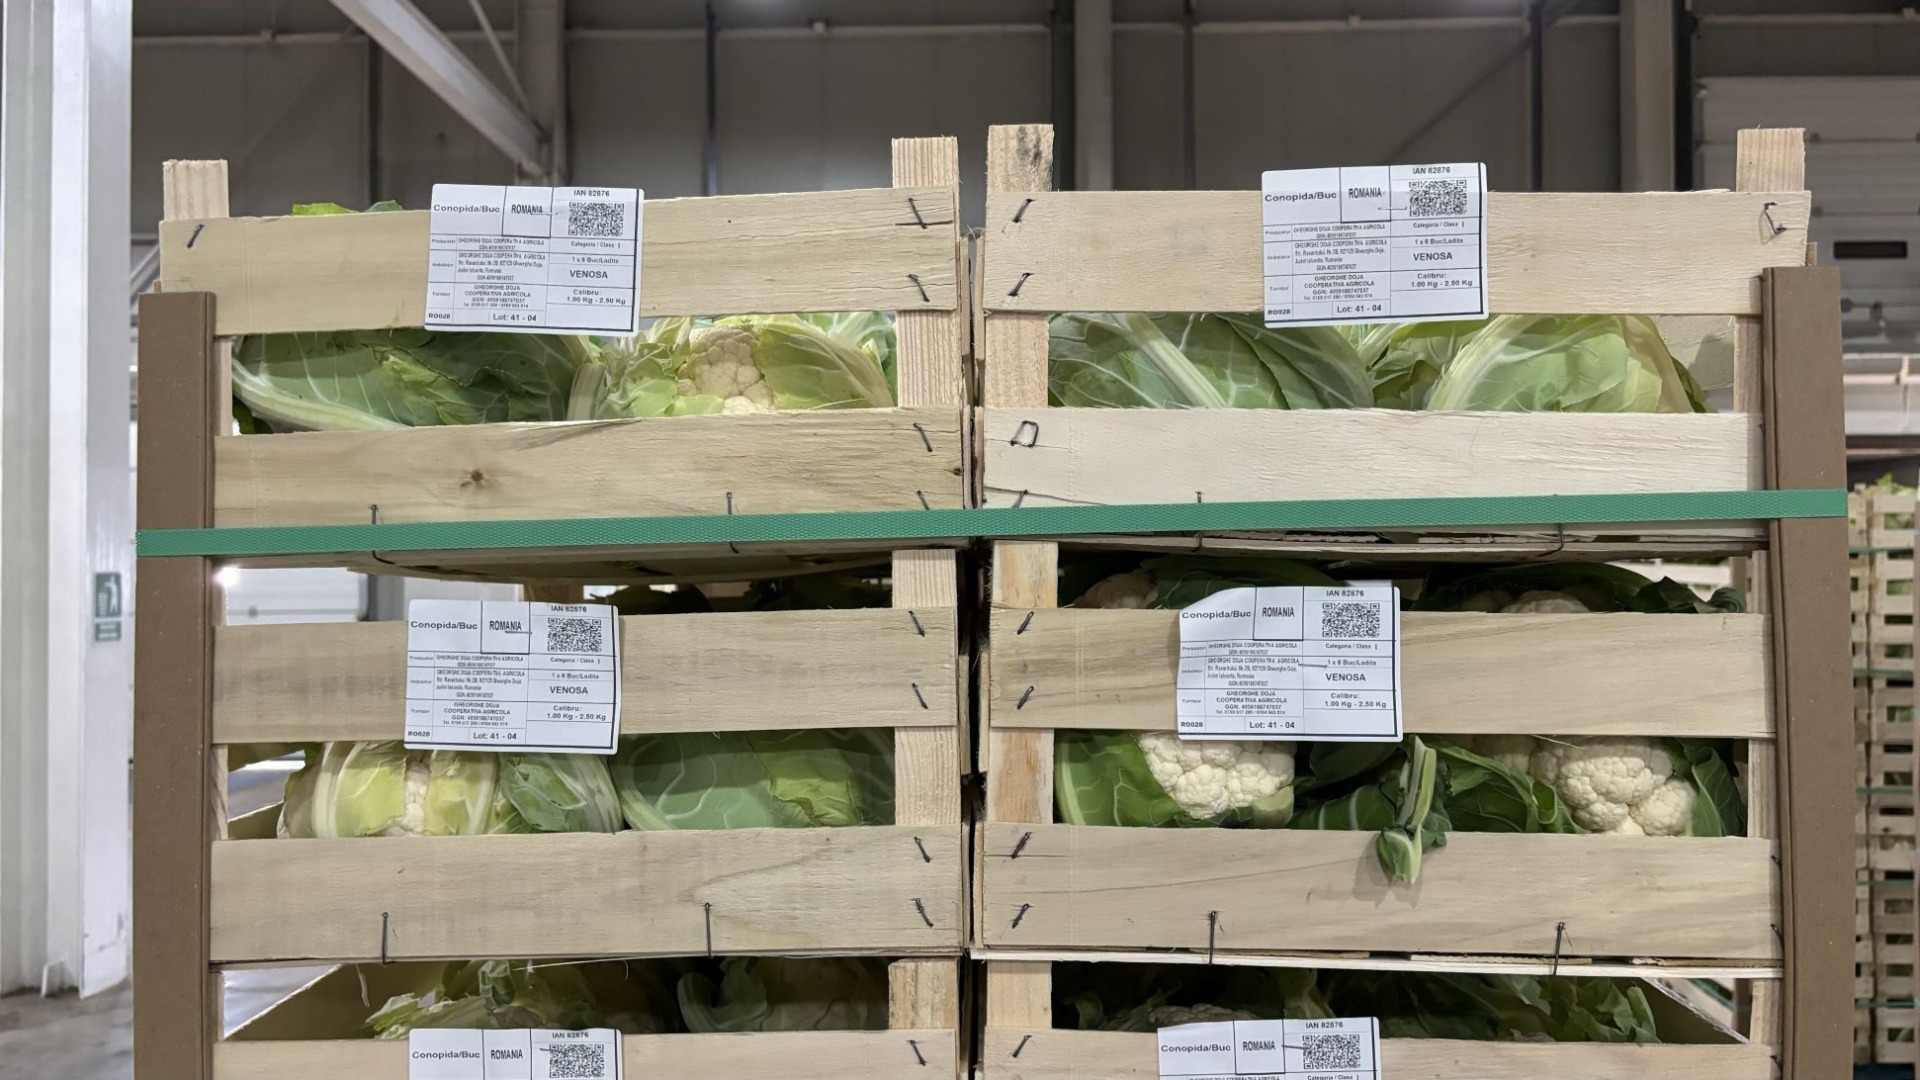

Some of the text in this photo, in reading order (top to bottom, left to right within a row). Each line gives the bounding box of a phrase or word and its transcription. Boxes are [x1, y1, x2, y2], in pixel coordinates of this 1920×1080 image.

[1265, 192, 1337, 202] Conopida/Buc
[1348, 188, 1382, 199] ROMANIA
[434, 204, 500, 213] Conopida/Buc
[511, 204, 543, 214] ROMANIA
[1413, 252, 1453, 261] VENOSA
[570, 270, 608, 278] VENOSA
[1182, 610, 1251, 619] Conopida/Buc
[1262, 607, 1295, 617] ROMANIA
[411, 621, 478, 630] Conopida/Buc
[489, 621, 522, 631] ROMANIA
[1326, 673, 1366, 681] VENOSA
[550, 686, 588, 694] VENOSA
[1161, 1044, 1231, 1053] Conopida/Buc
[1242, 1041, 1276, 1051] ROMANIA
[412, 1051, 480, 1059] Conopida/Buc
[490, 1049, 523, 1059] ROMANIA
